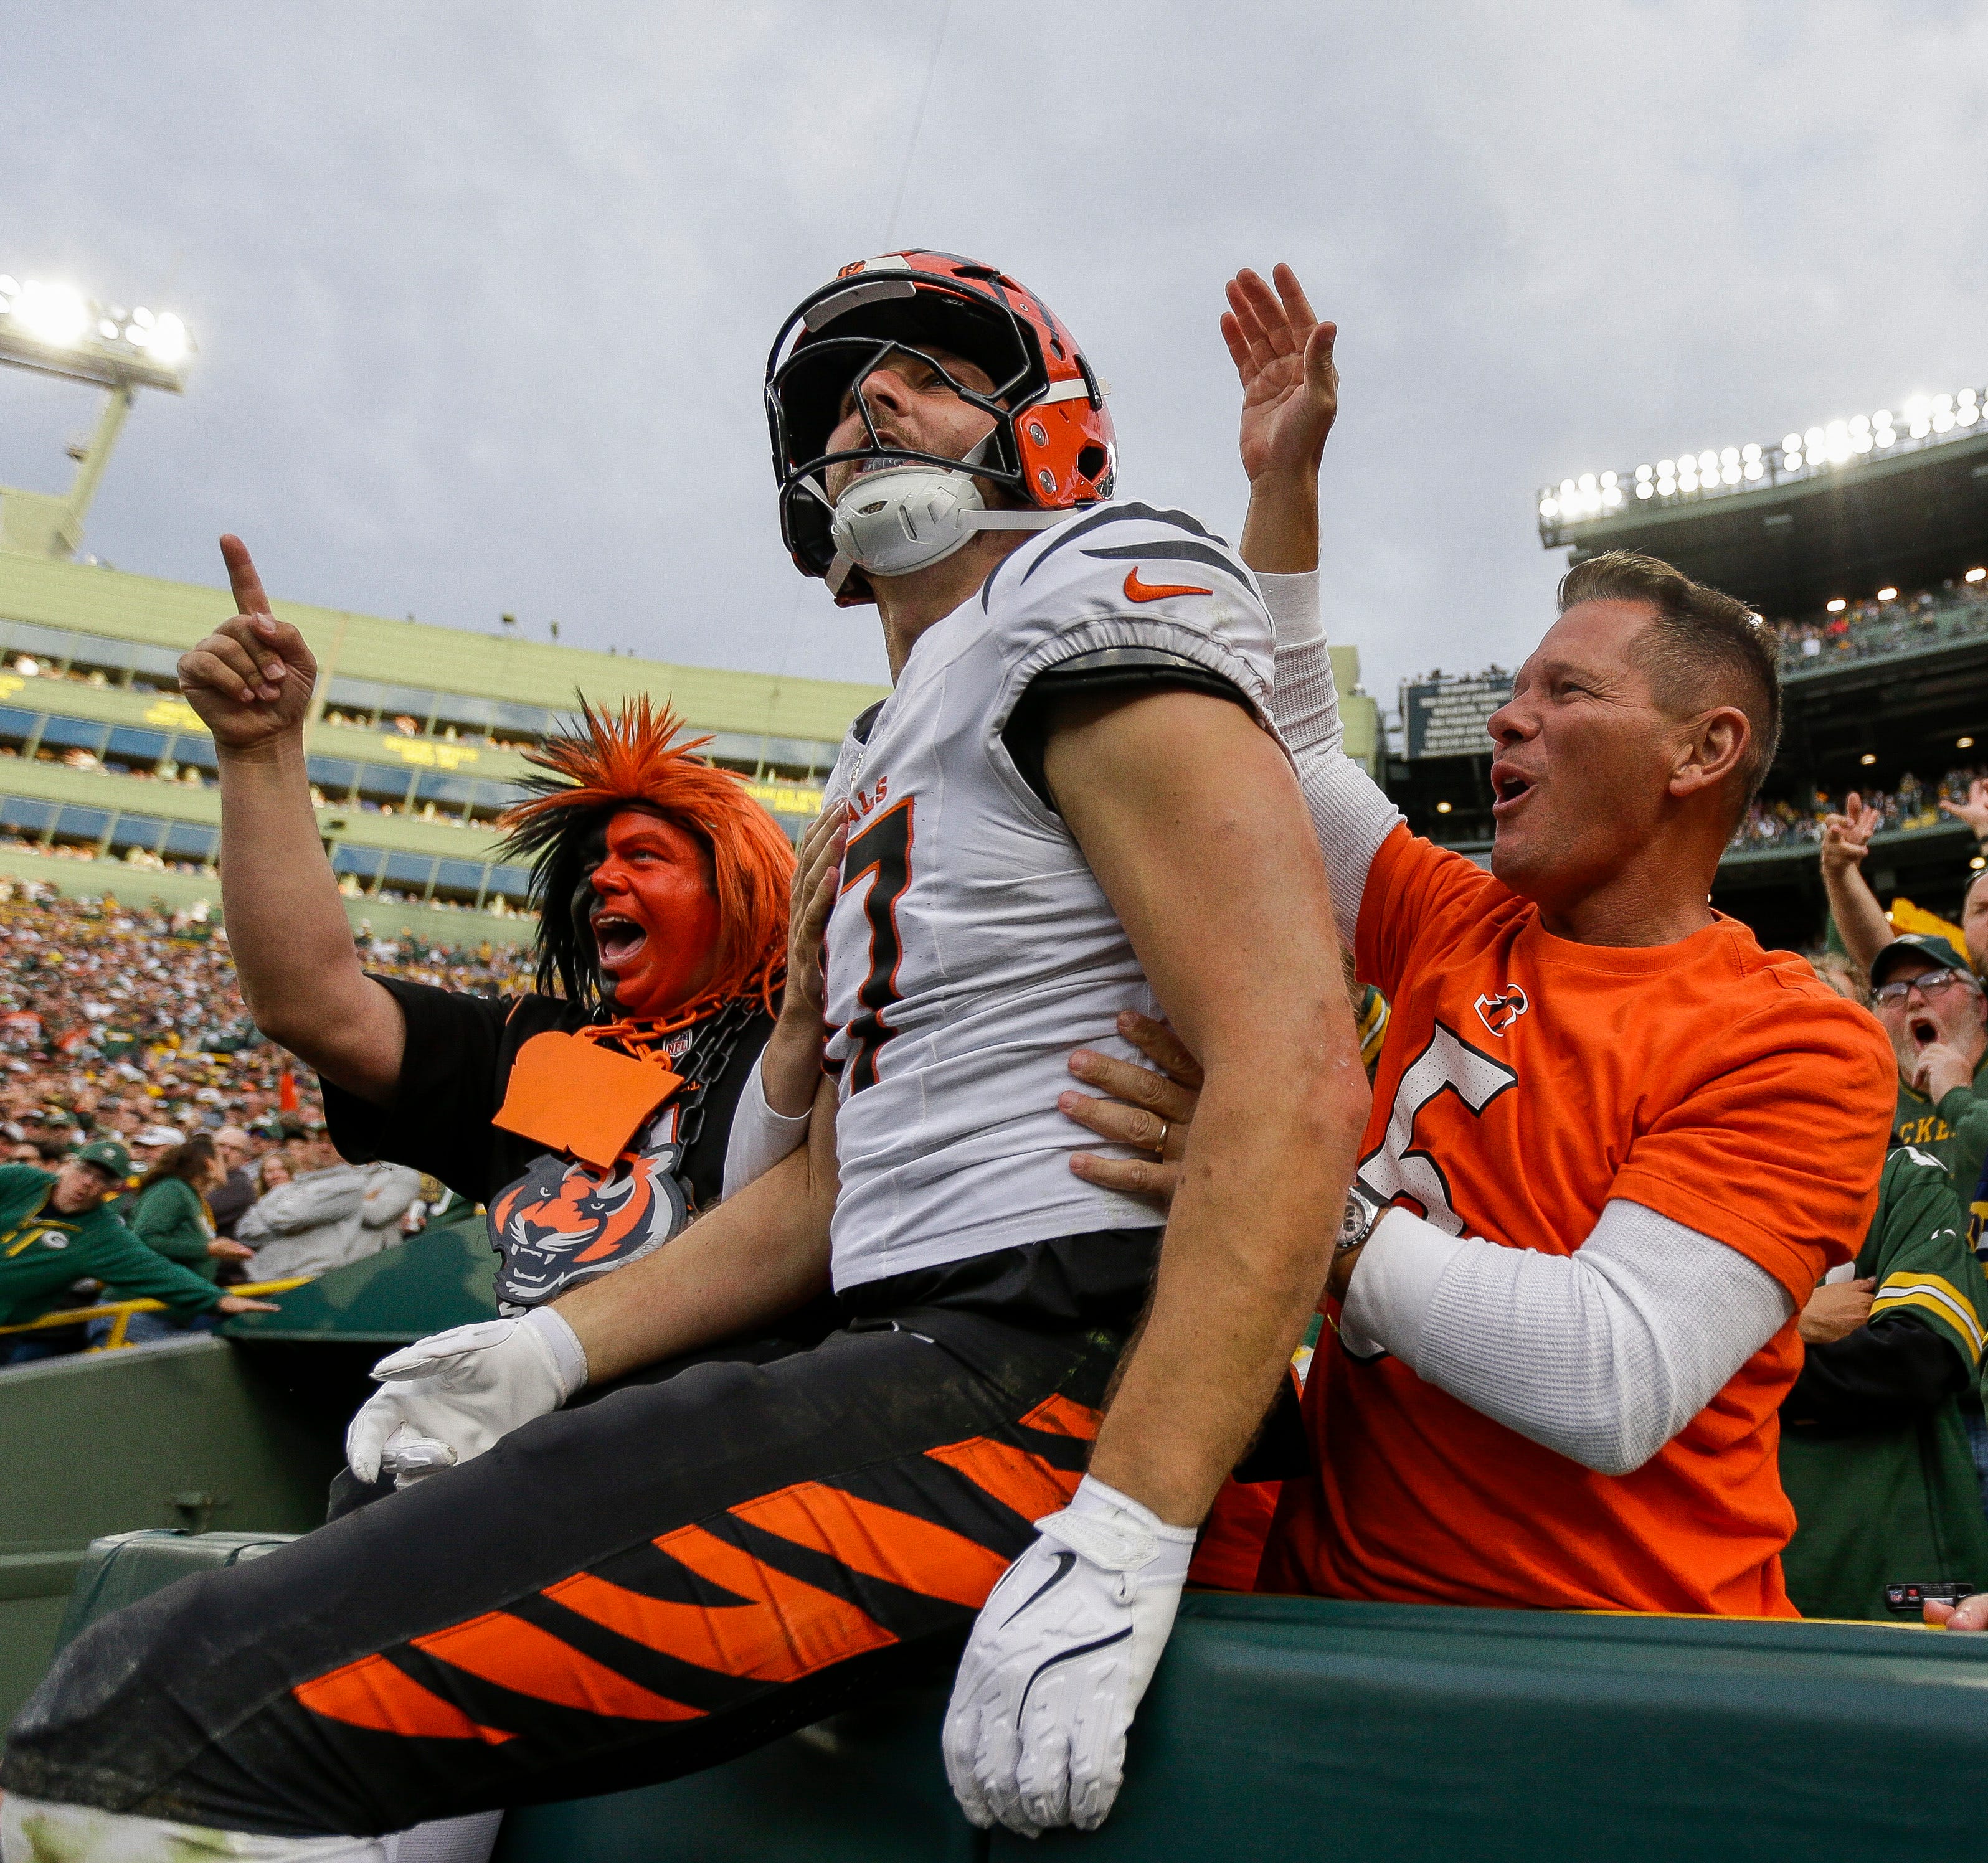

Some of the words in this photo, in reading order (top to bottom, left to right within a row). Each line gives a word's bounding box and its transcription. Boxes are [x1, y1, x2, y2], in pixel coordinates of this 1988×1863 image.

[821, 796, 914, 1096] 7
[668, 1041, 688, 1054] NFL
[1899, 1115, 1956, 1144] CKE
